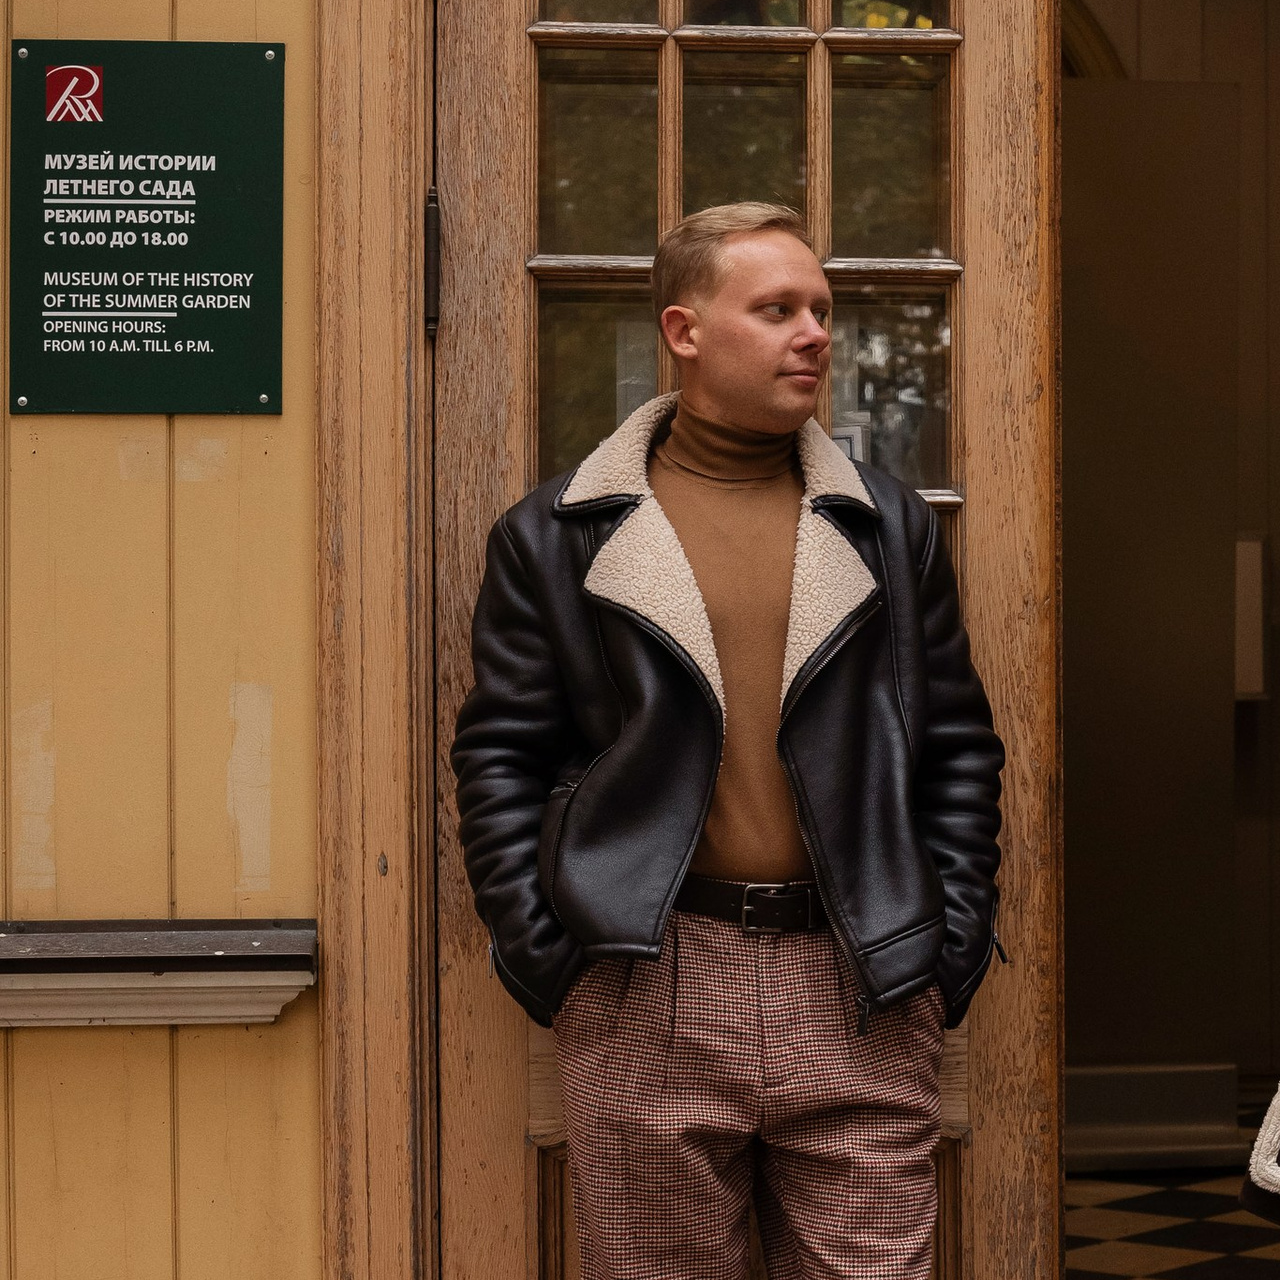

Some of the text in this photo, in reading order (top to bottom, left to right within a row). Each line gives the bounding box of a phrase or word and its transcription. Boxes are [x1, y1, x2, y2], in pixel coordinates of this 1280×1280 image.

[44, 150, 216, 171] МУЗЕЙ ИСТОРИИ
[43, 178, 196, 198] ЛЕТНЕГО САДА
[44, 209, 196, 225] РЕЖИМ РАБОТЫ:
[59, 231, 107, 246] 10.00
[109, 231, 138, 249] ДО
[141, 231, 189, 246] 18.00
[43, 271, 254, 287] MUSEUM OF THE HISTORY
[43, 293, 251, 309] OF THE SUMMER GARDEN
[43, 320, 166, 334] OPENING HOURS:
[43, 339, 215, 353] FROM 10 A.M. TILL 6 P.M.
